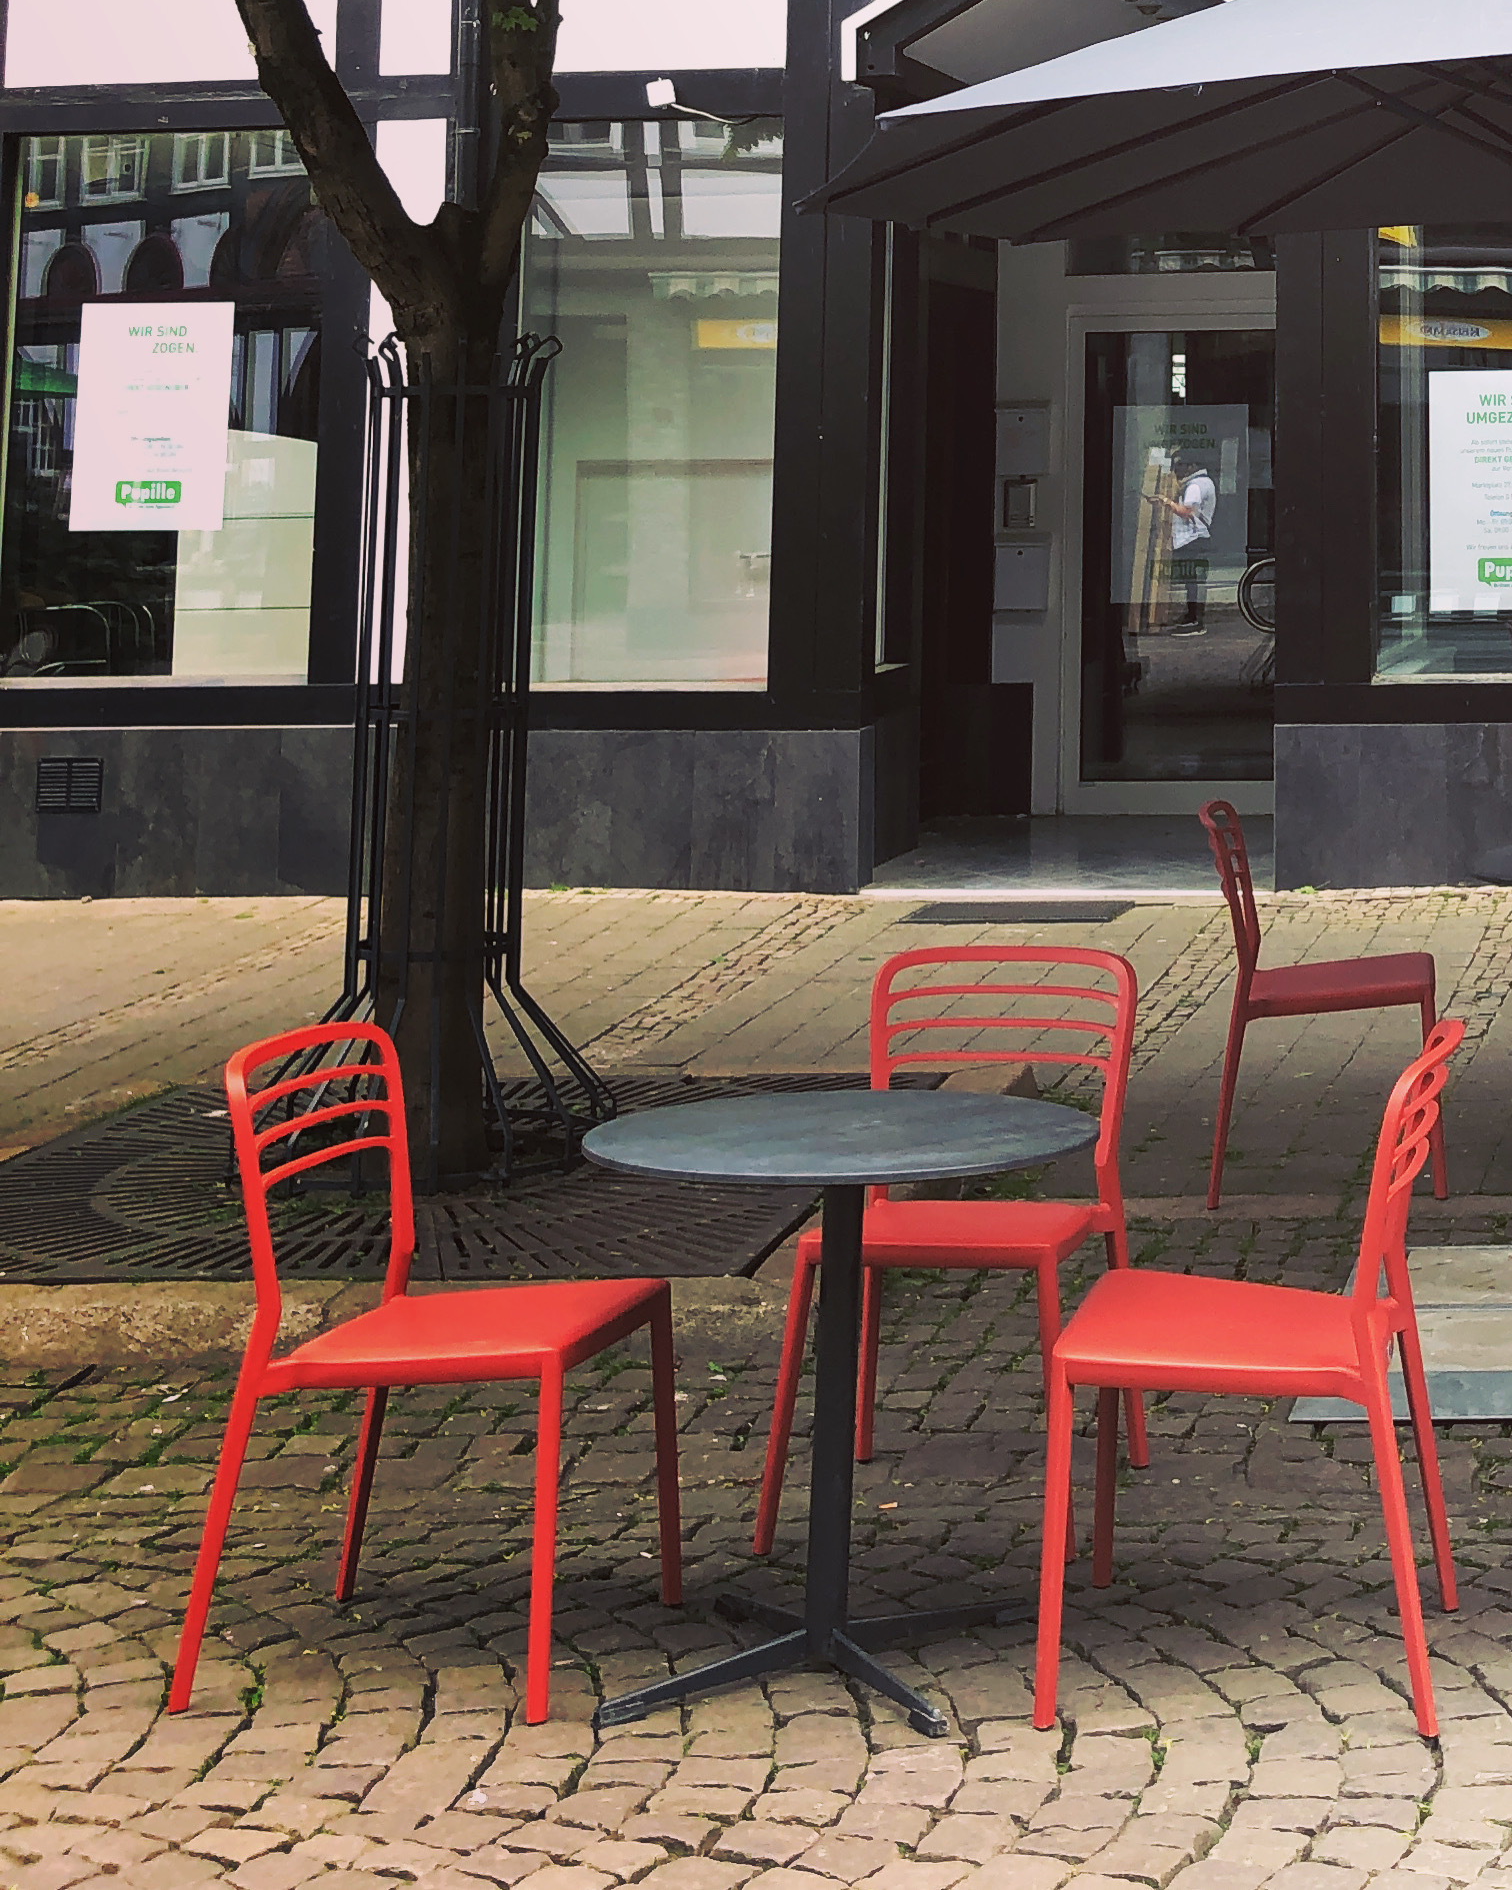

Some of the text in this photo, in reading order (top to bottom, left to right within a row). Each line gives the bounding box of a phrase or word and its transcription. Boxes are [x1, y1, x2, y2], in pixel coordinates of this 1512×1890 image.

[128, 325, 188, 337] WIR SIND
[1479, 394, 1506, 407] WIR
[1180, 423, 1208, 435] SIND
[120, 481, 176, 502] Pupille
